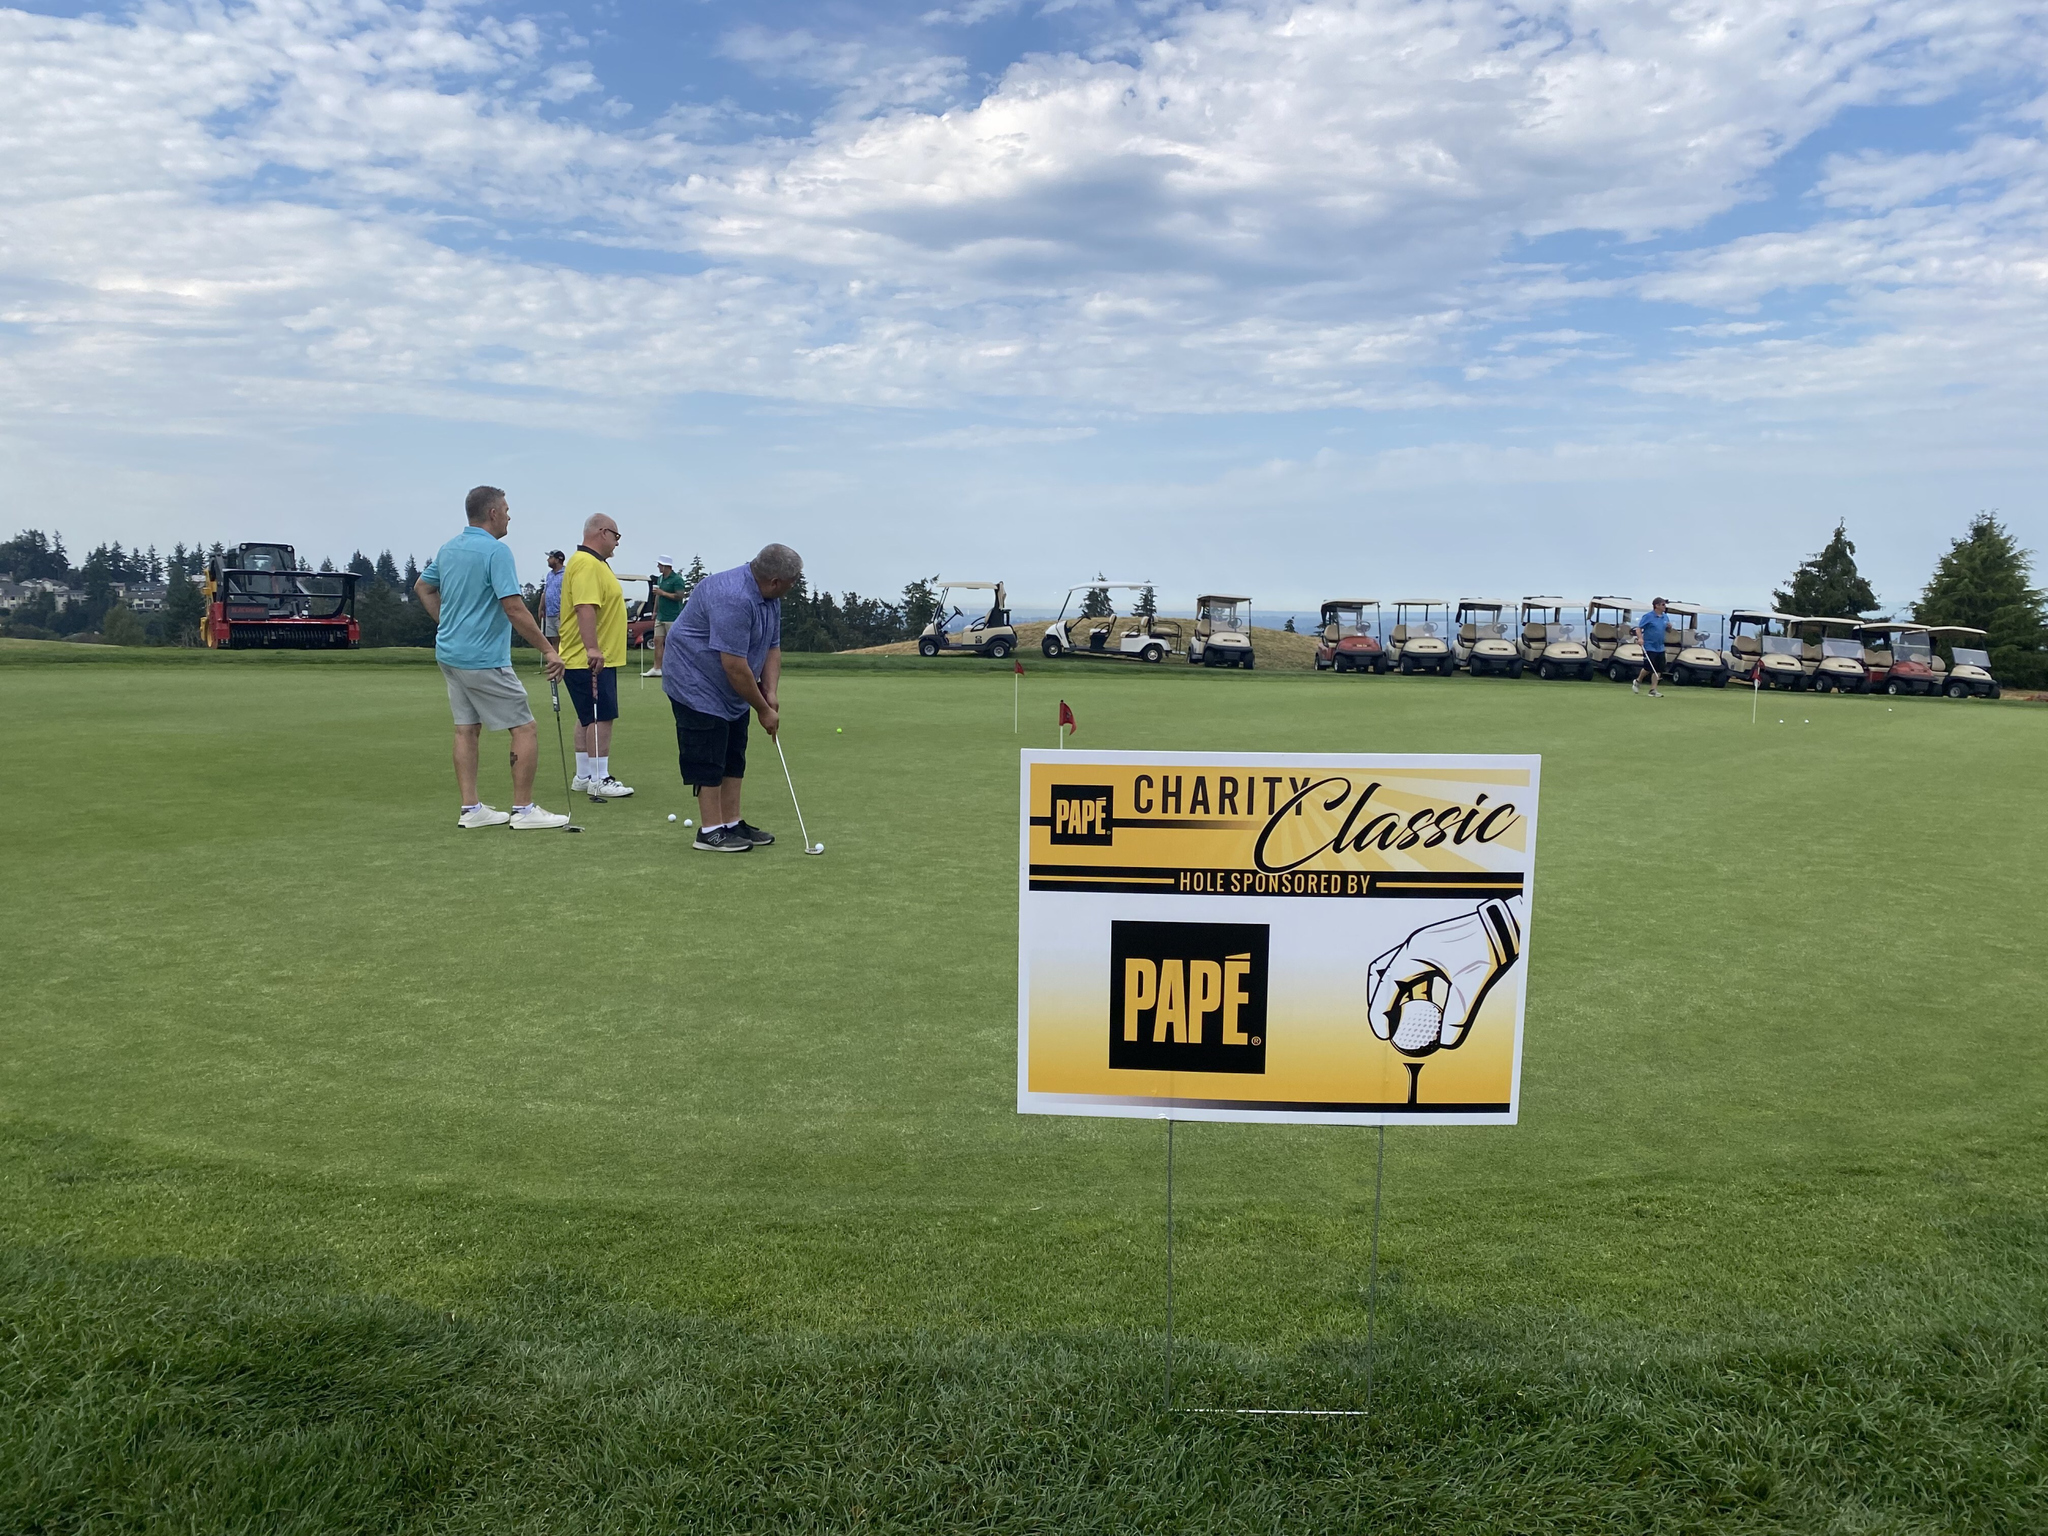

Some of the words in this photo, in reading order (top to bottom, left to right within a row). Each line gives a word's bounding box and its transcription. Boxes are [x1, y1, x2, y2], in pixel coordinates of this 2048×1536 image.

[1133, 774, 1311, 816] CHARITY
[1253, 777, 1521, 874] Classic
[1179, 871, 1225, 893] HOLE
[1230, 871, 1341, 895] SPONSORED
[1347, 874, 1371, 895] BY
